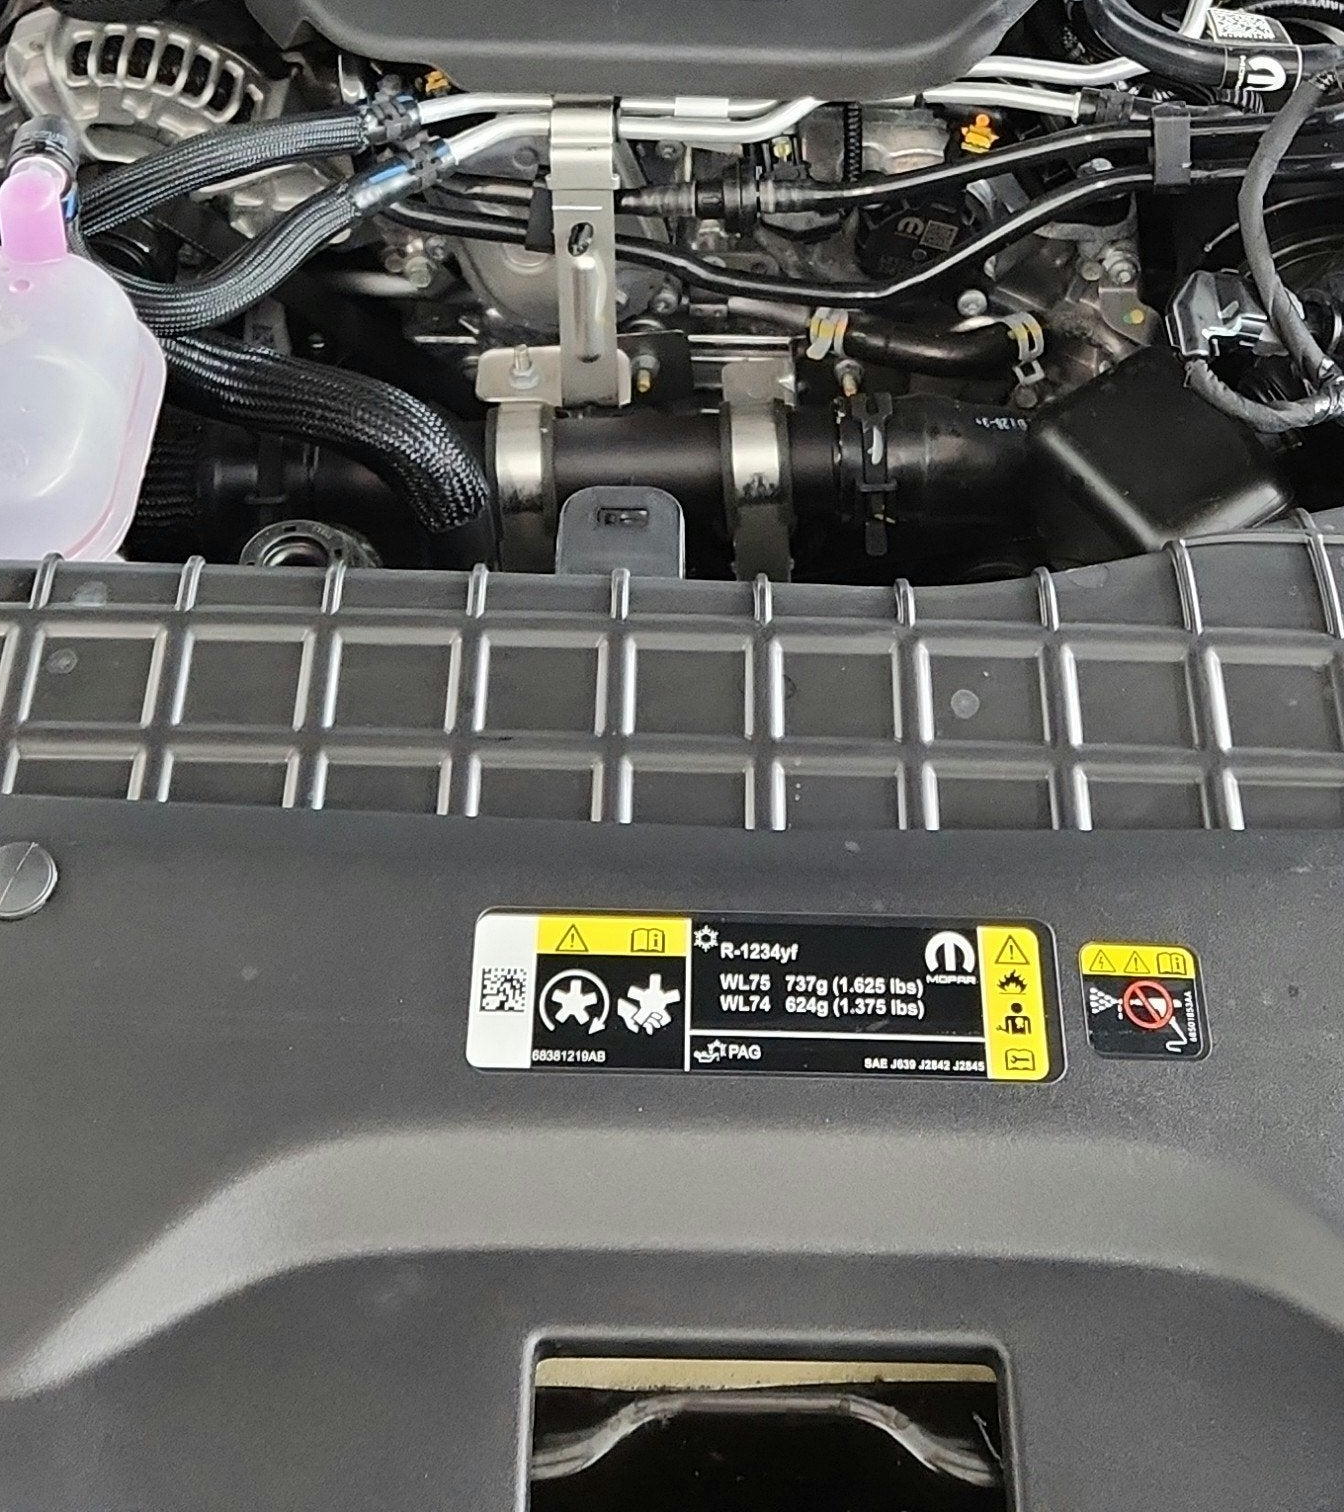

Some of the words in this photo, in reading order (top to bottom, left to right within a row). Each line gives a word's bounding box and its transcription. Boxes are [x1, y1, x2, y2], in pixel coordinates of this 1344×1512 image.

[719, 941, 799, 964] R-1234yf
[719, 973, 771, 991] WL75
[785, 974, 829, 996] 737g
[832, 976, 886, 997] (1.625
[889, 977, 924, 999] lbs)
[719, 994, 771, 1012] WL74
[785, 996, 829, 1017] 624g
[832, 997, 887, 1018] (1.375
[890, 998, 925, 1020] lbs)
[532, 1049, 606, 1063] 68381219AB
[728, 1044, 762, 1060] PAG
[863, 1057, 888, 1069] SAE
[890, 1058, 916, 1071] J639
[918, 1059, 951, 1071] J2842
[952, 1060, 985, 1072] J2845
